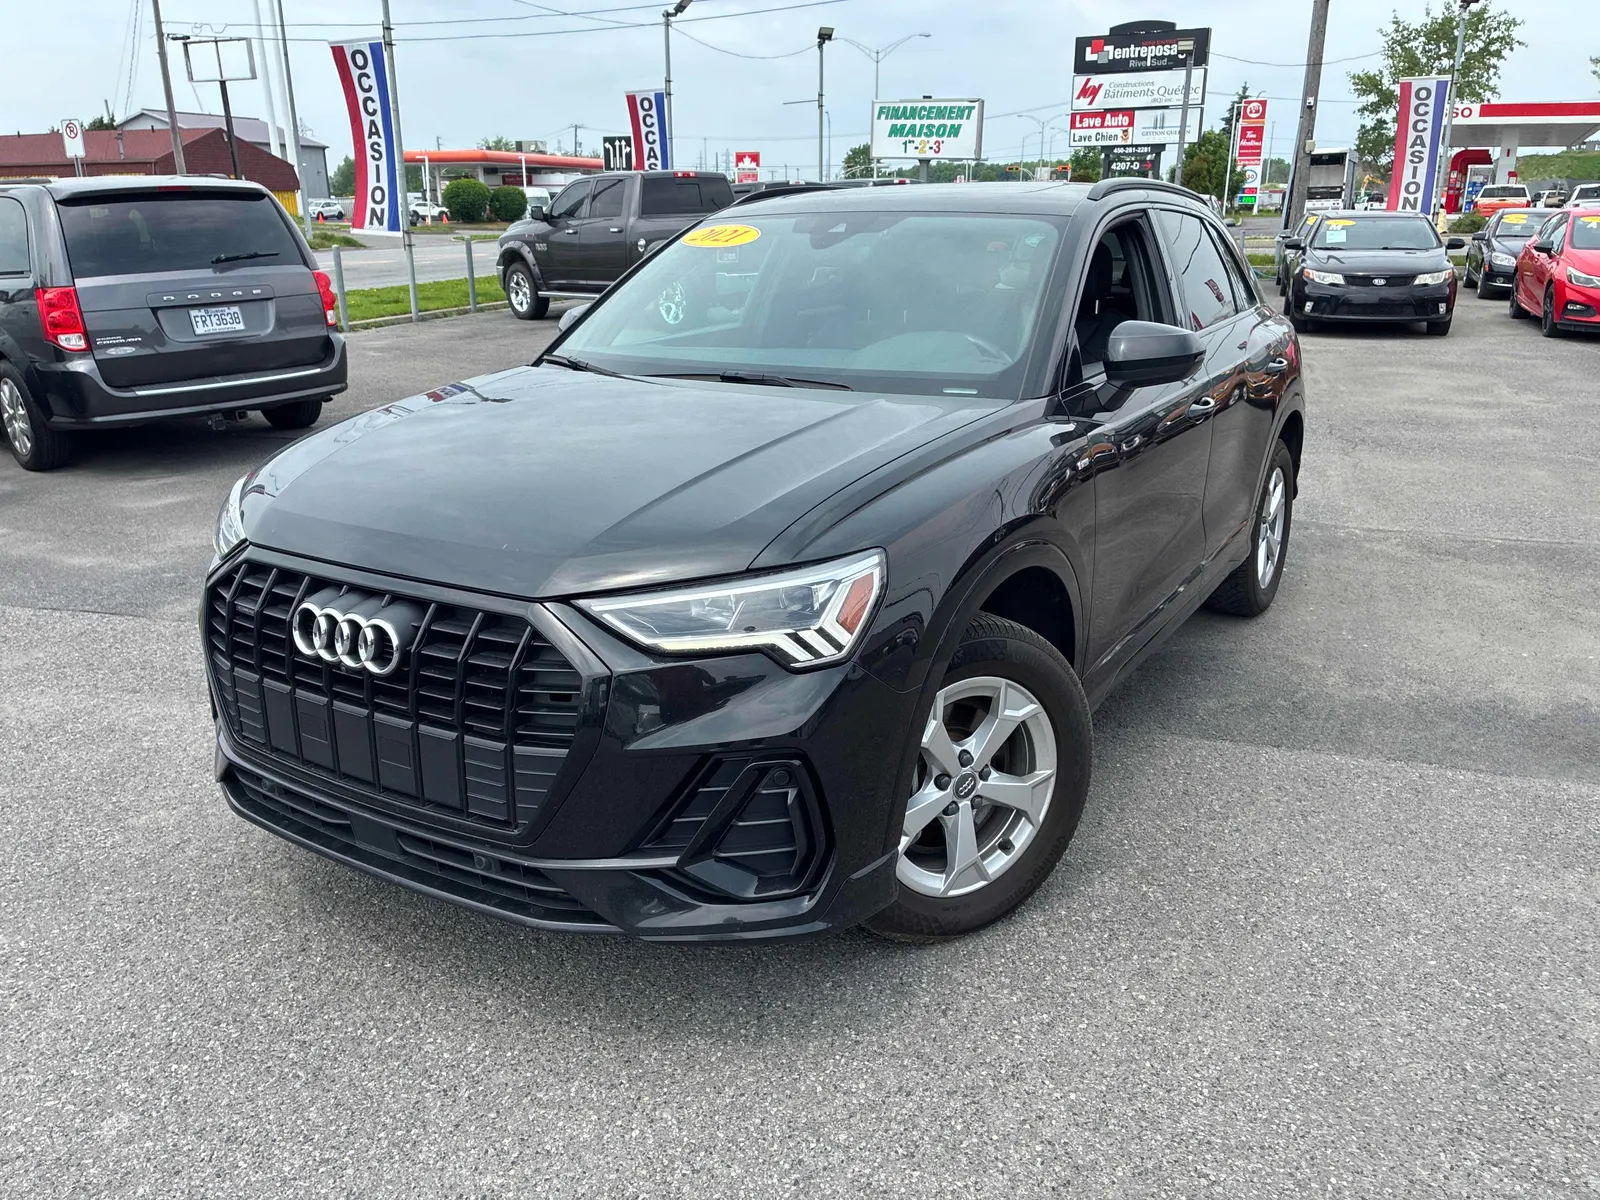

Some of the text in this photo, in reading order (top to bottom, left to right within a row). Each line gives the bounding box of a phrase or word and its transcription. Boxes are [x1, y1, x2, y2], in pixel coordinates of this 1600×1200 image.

[1114, 43, 1186, 66] entreposa
[1129, 59, 1147, 68] Rive
[1151, 58, 1167, 66] Sud
[1108, 81, 1155, 89] Constructions
[1103, 88, 1155, 99] Bâtiments
[877, 105, 976, 120] FINANCEMENT
[1075, 113, 1129, 128] Lave Auto
[350, 48, 386, 227] OCCASION
[639, 96, 659, 171] OCCAS
[887, 123, 963, 138] MAISON
[1072, 131, 1119, 143] Lave Chien
[1245, 130, 1257, 139] Tim
[1401, 86, 1432, 211] OCCASION
[1111, 161, 1140, 171] 4207-D
[687, 228, 751, 243] 2021
[163, 289, 261, 301] DODGE
[193, 311, 241, 328] FRT3638
